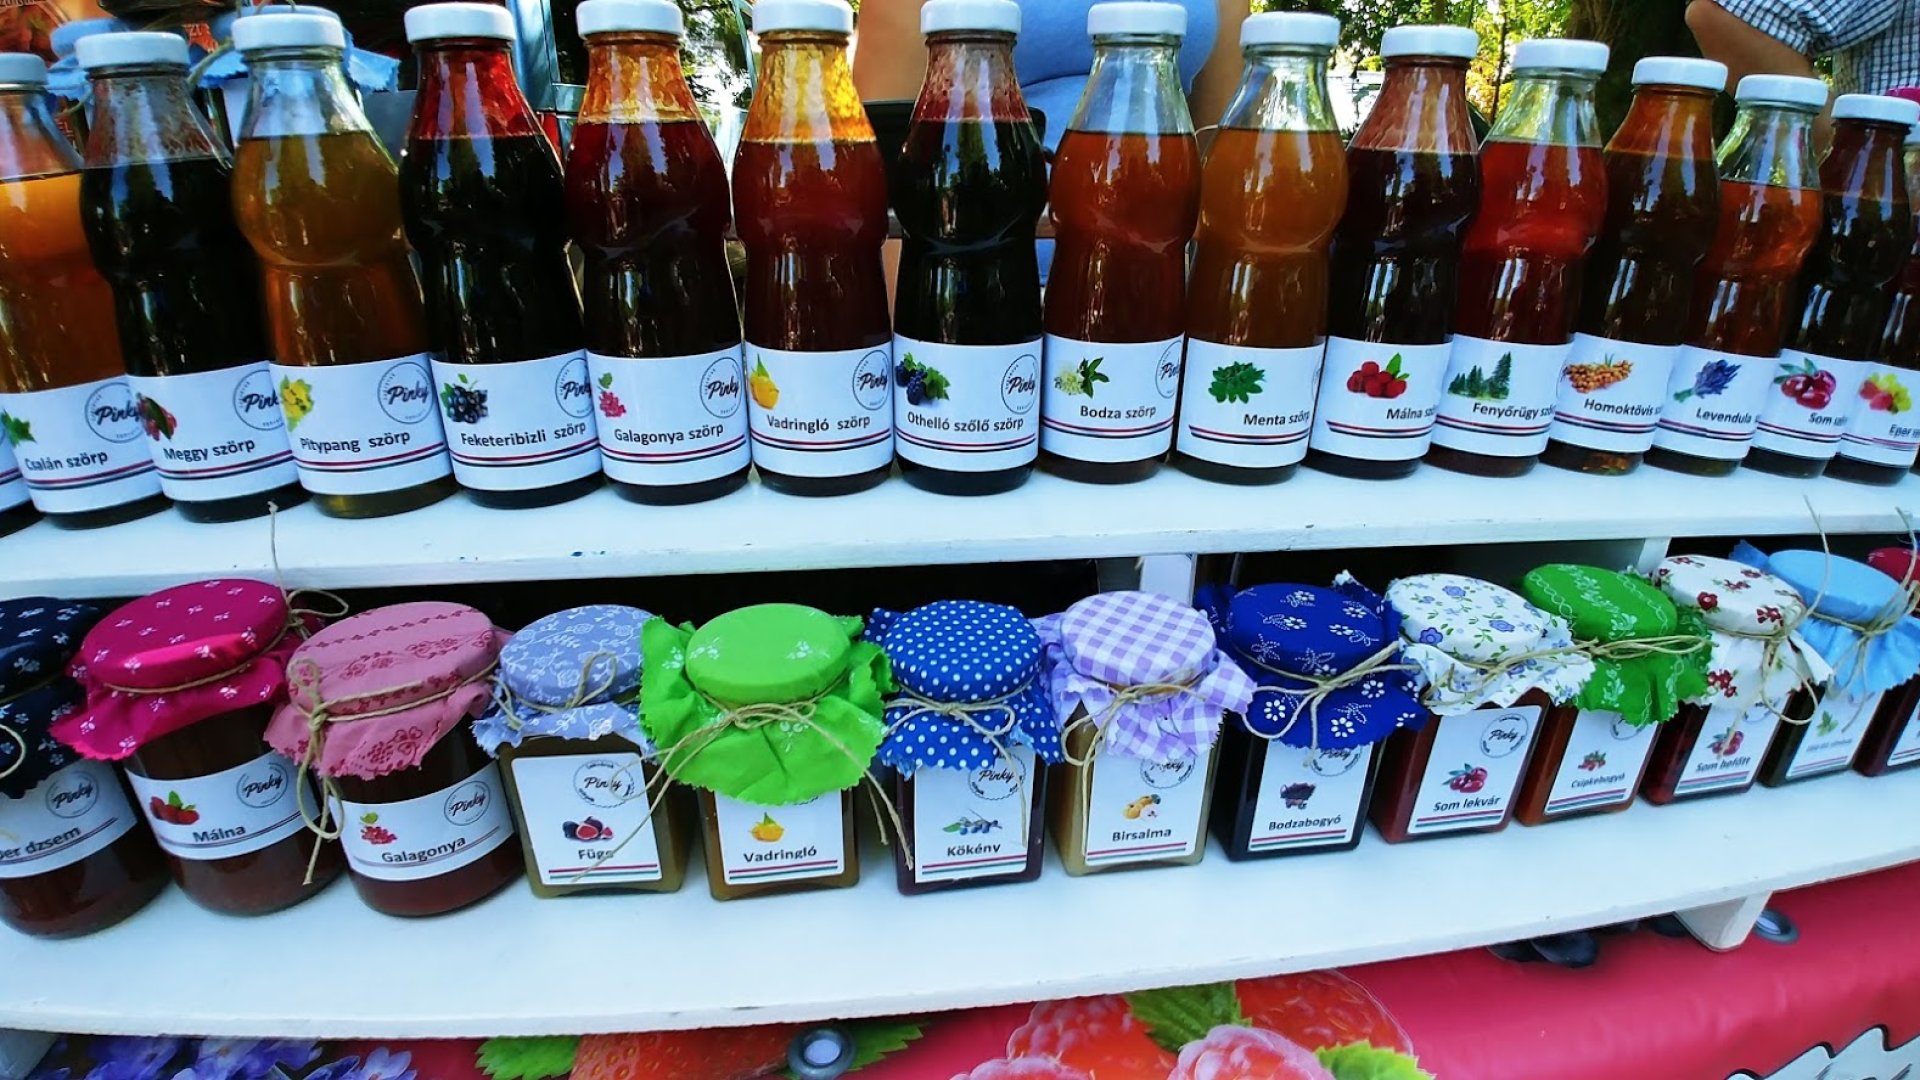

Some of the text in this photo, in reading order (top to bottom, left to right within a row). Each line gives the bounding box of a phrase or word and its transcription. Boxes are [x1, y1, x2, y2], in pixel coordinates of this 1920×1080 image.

[707, 375, 739, 400] Pinky
[859, 368, 888, 391] Pinky
[1008, 373, 1036, 396] Pinky
[242, 387, 280, 413] Pink
[386, 380, 429, 405] Pinky
[1080, 405, 1156, 420] Bodza szörp
[1386, 407, 1422, 420] Málna
[1472, 402, 1539, 420] Fenyőrügy
[1584, 398, 1654, 416] Homoktövis
[1696, 407, 1752, 424] Levendula
[766, 414, 871, 434] Vadringló szörp
[907, 411, 1024, 432] Othelló szőlő szörp
[1243, 413, 1286, 426] Menta
[1808, 412, 1832, 425] Som
[460, 422, 587, 447] Feketeribizli szörp
[614, 423, 724, 446] Galagonya szörp
[1889, 423, 1913, 438] Eper
[162, 440, 256, 463] Meggy szörp
[299, 431, 411, 454] Pitypang szörp
[24, 450, 109, 472] Csalán szörp
[1488, 727, 1519, 743] Pinky
[978, 767, 1015, 783] Pinky
[242, 774, 284, 798] Pinky
[450, 792, 487, 817] Pinky
[1433, 794, 1502, 812] Som lekvár
[1268, 814, 1342, 831] Bodzabogyó
[25, 826, 82, 854] dzsem
[192, 825, 246, 843] Málna
[1112, 828, 1172, 843] Birsalma
[381, 836, 466, 863] Galagonya
[743, 845, 817, 863] Vadringló
